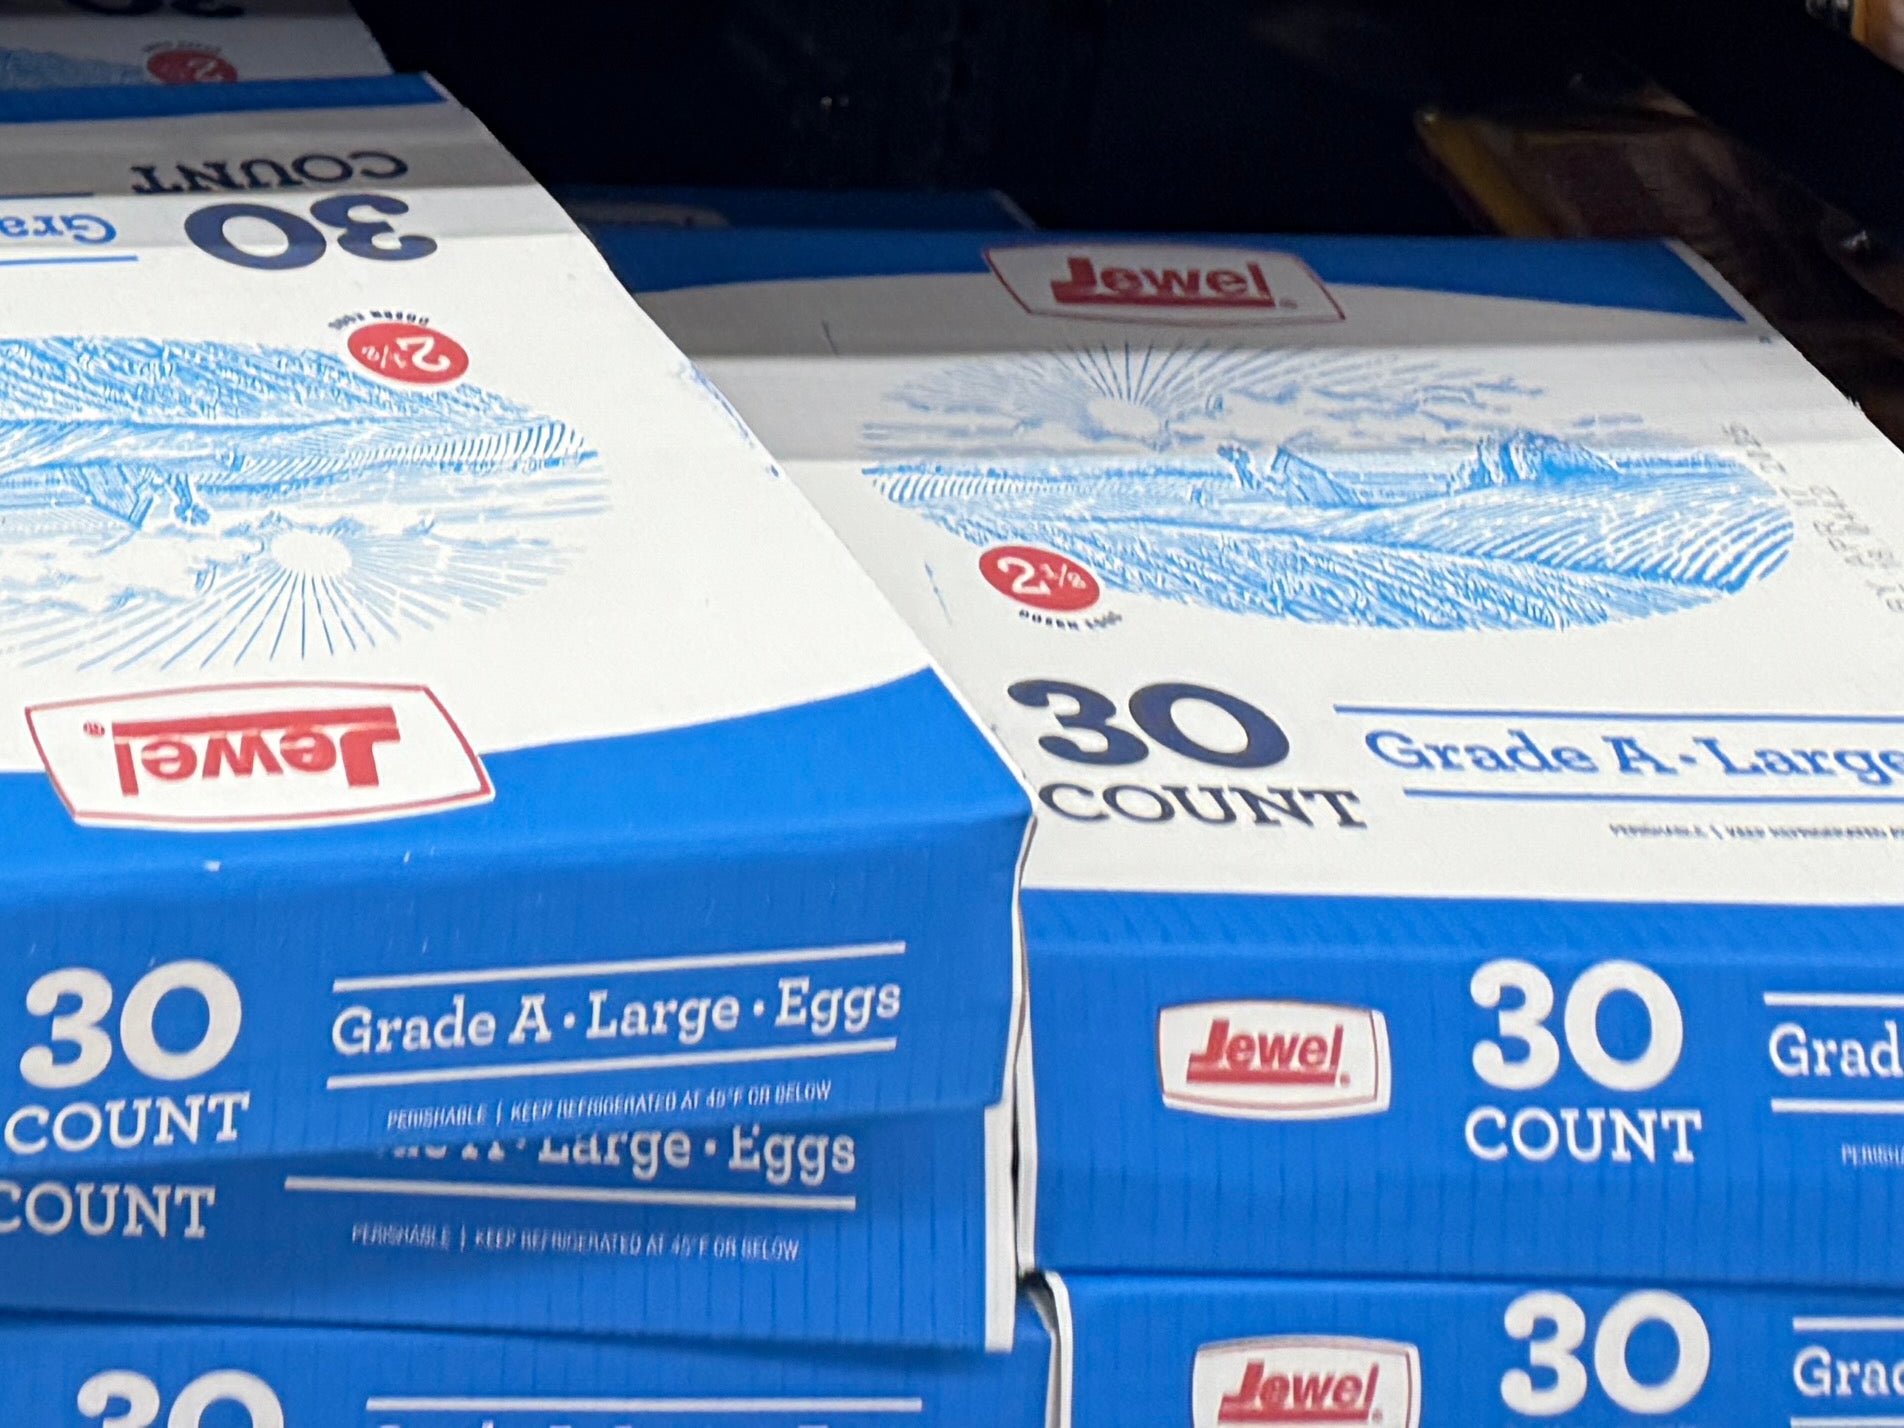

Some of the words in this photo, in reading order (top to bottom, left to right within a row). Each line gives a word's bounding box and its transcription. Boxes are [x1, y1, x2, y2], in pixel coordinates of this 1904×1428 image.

[129, 153, 409, 196] COUNT
[182, 193, 439, 270] 30
[1051, 257, 1274, 300] Jewel
[1007, 678, 1291, 769] 30
[1364, 727, 1600, 774] Grade
[1601, 732, 1680, 777] A
[112, 724, 401, 797] Jewel
[1036, 781, 1369, 829] COUNT
[19, 959, 243, 1091] 30
[332, 993, 497, 1055] Grade
[508, 993, 553, 1043] A
[586, 989, 740, 1044] Large
[774, 977, 901, 1035] Eggs
[1188, 1017, 1345, 1070] Jewel
[1470, 959, 1685, 1092] 30
[4, 1092, 252, 1155] COUNT
[387, 1101, 486, 1131] PERISHABLE
[511, 1097, 553, 1124] KEEP
[680, 1088, 702, 1112] AT
[775, 1080, 832, 1104] BELOW
[1463, 1105, 1704, 1164] COUNT
[1501, 1288, 1712, 1418] 30
[1220, 1361, 1379, 1410] Jewel
